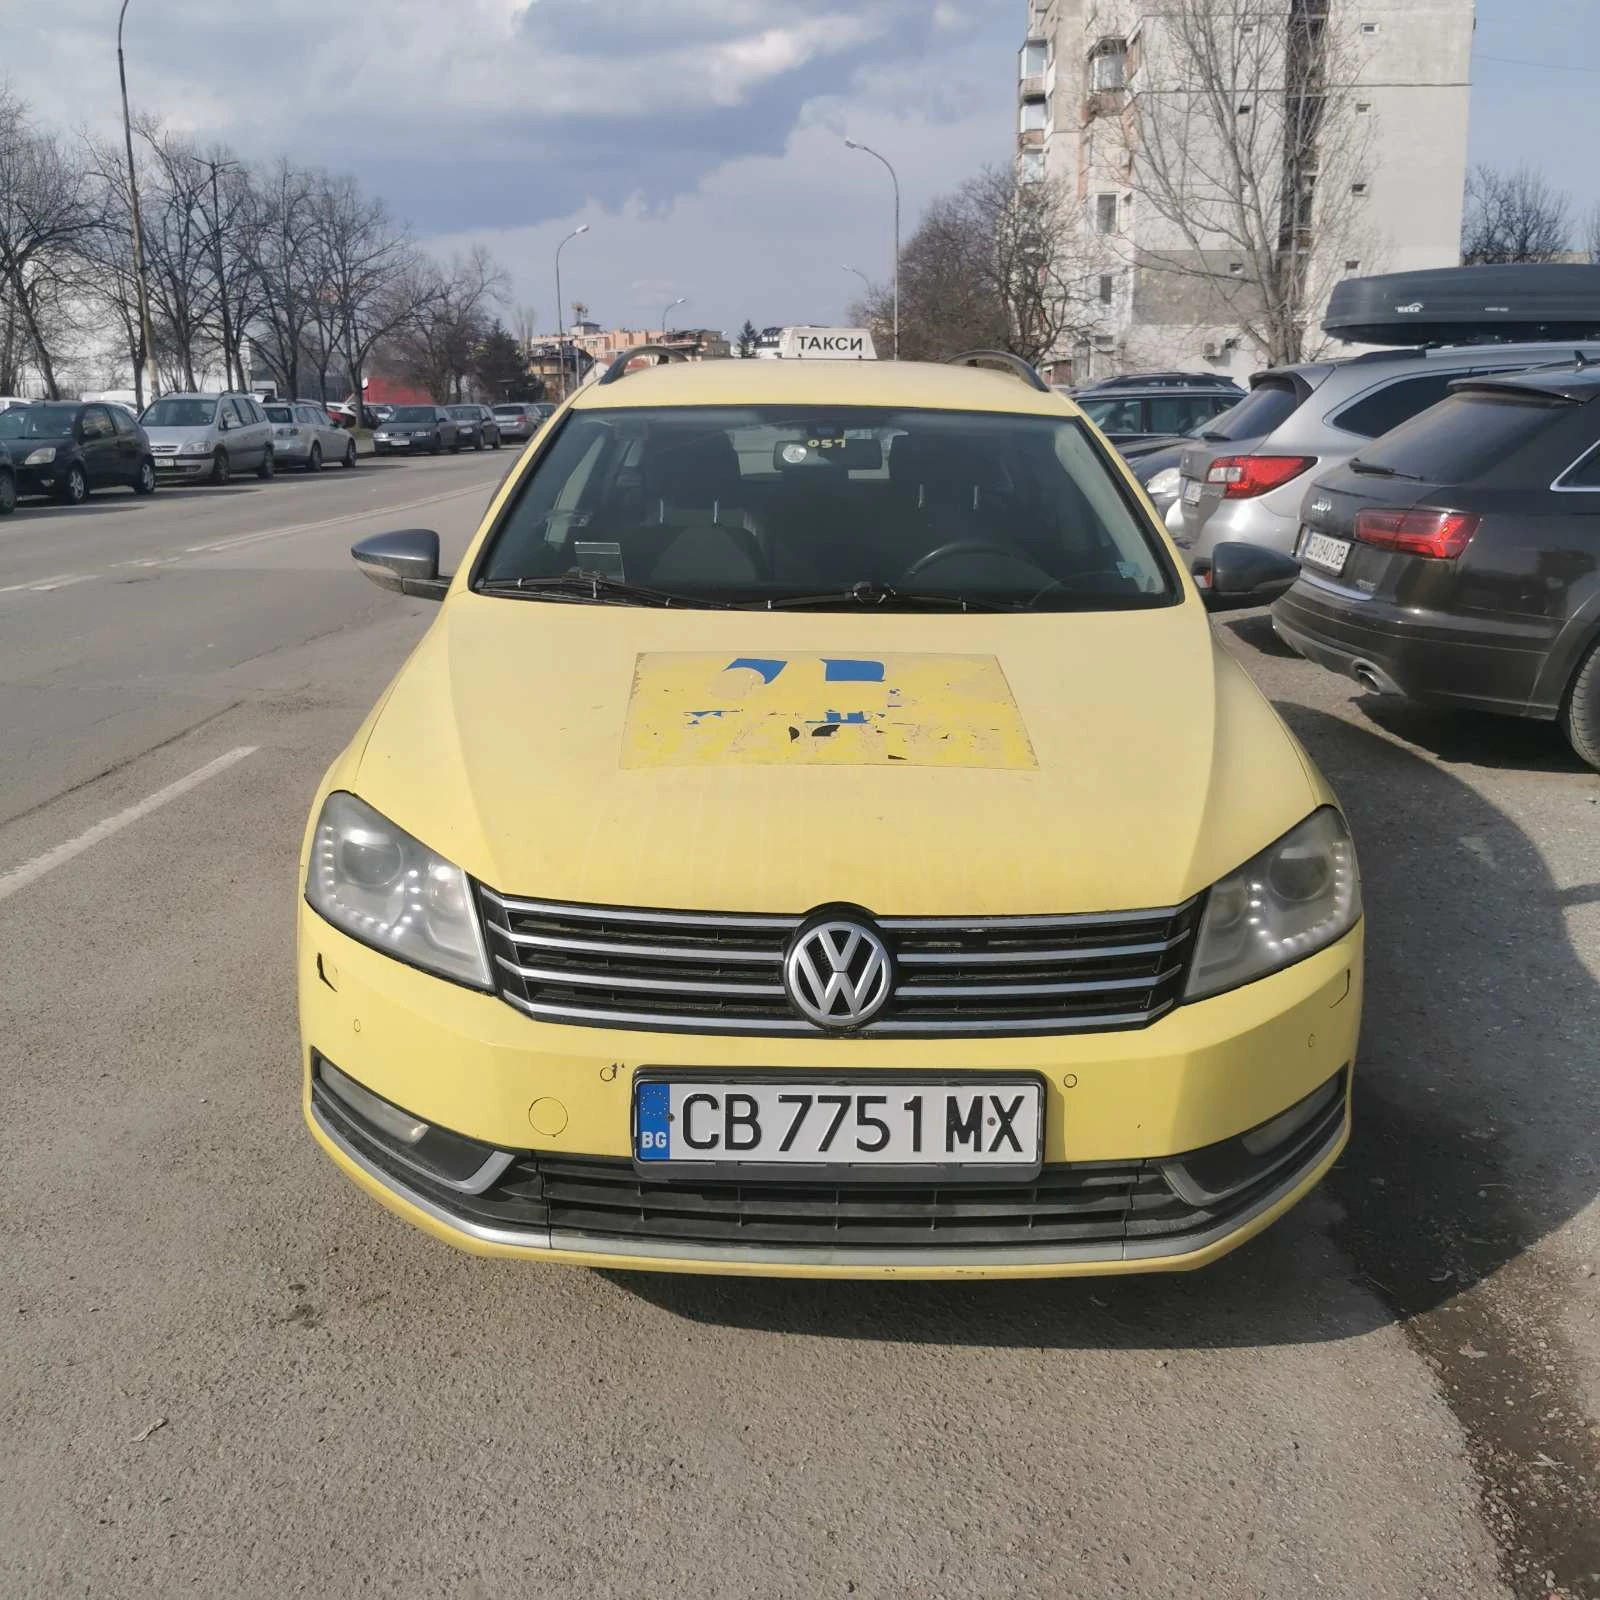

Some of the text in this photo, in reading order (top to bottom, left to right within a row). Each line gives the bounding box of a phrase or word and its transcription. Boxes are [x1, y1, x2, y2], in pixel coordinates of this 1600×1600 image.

[797, 335, 863, 352] ТАКСИ
[682, 1093, 1025, 1153] CB 7751 MX
[641, 1131, 667, 1149] BG
